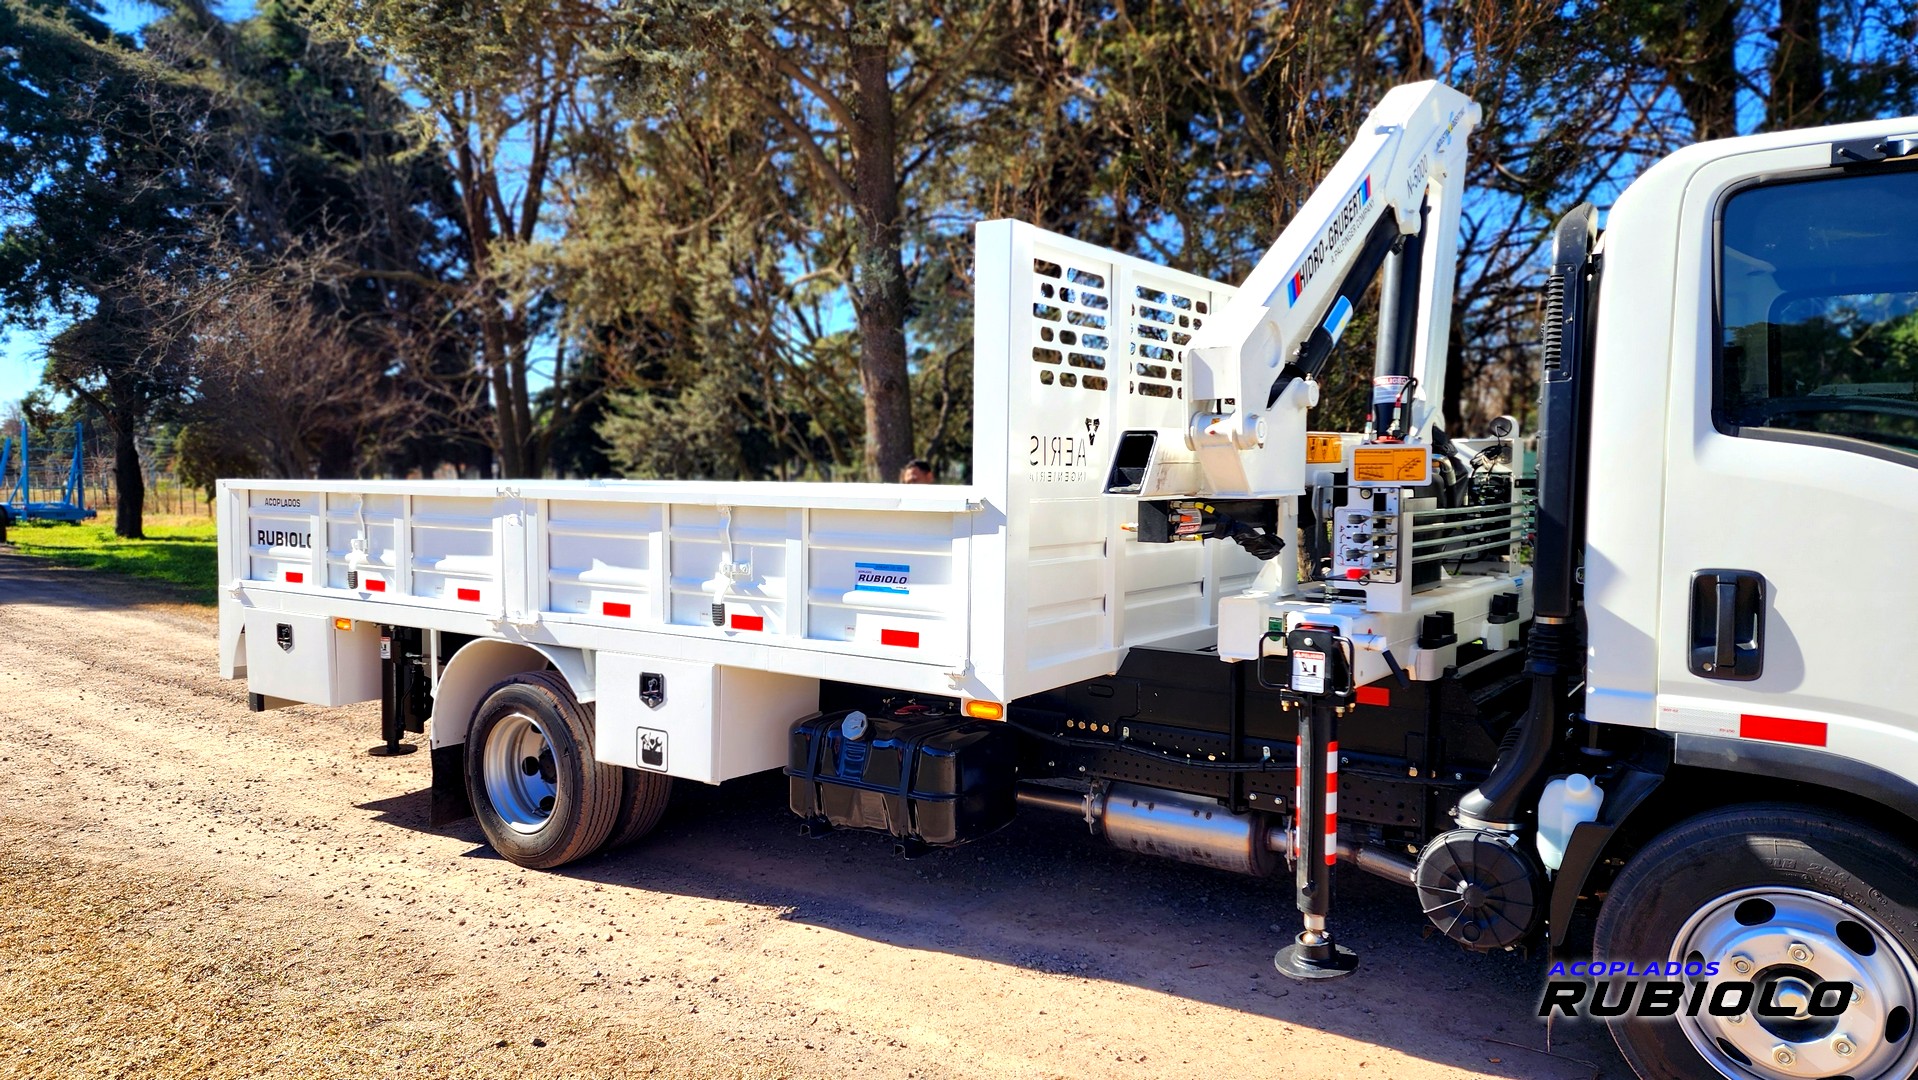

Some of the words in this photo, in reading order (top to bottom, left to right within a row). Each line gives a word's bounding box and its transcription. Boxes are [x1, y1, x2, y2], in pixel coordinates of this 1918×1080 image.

[1299, 187, 1362, 288] HIDRO-GRUBERT
[265, 497, 300, 507] ACOPLADOS
[858, 573, 907, 584] RUBIOLO
